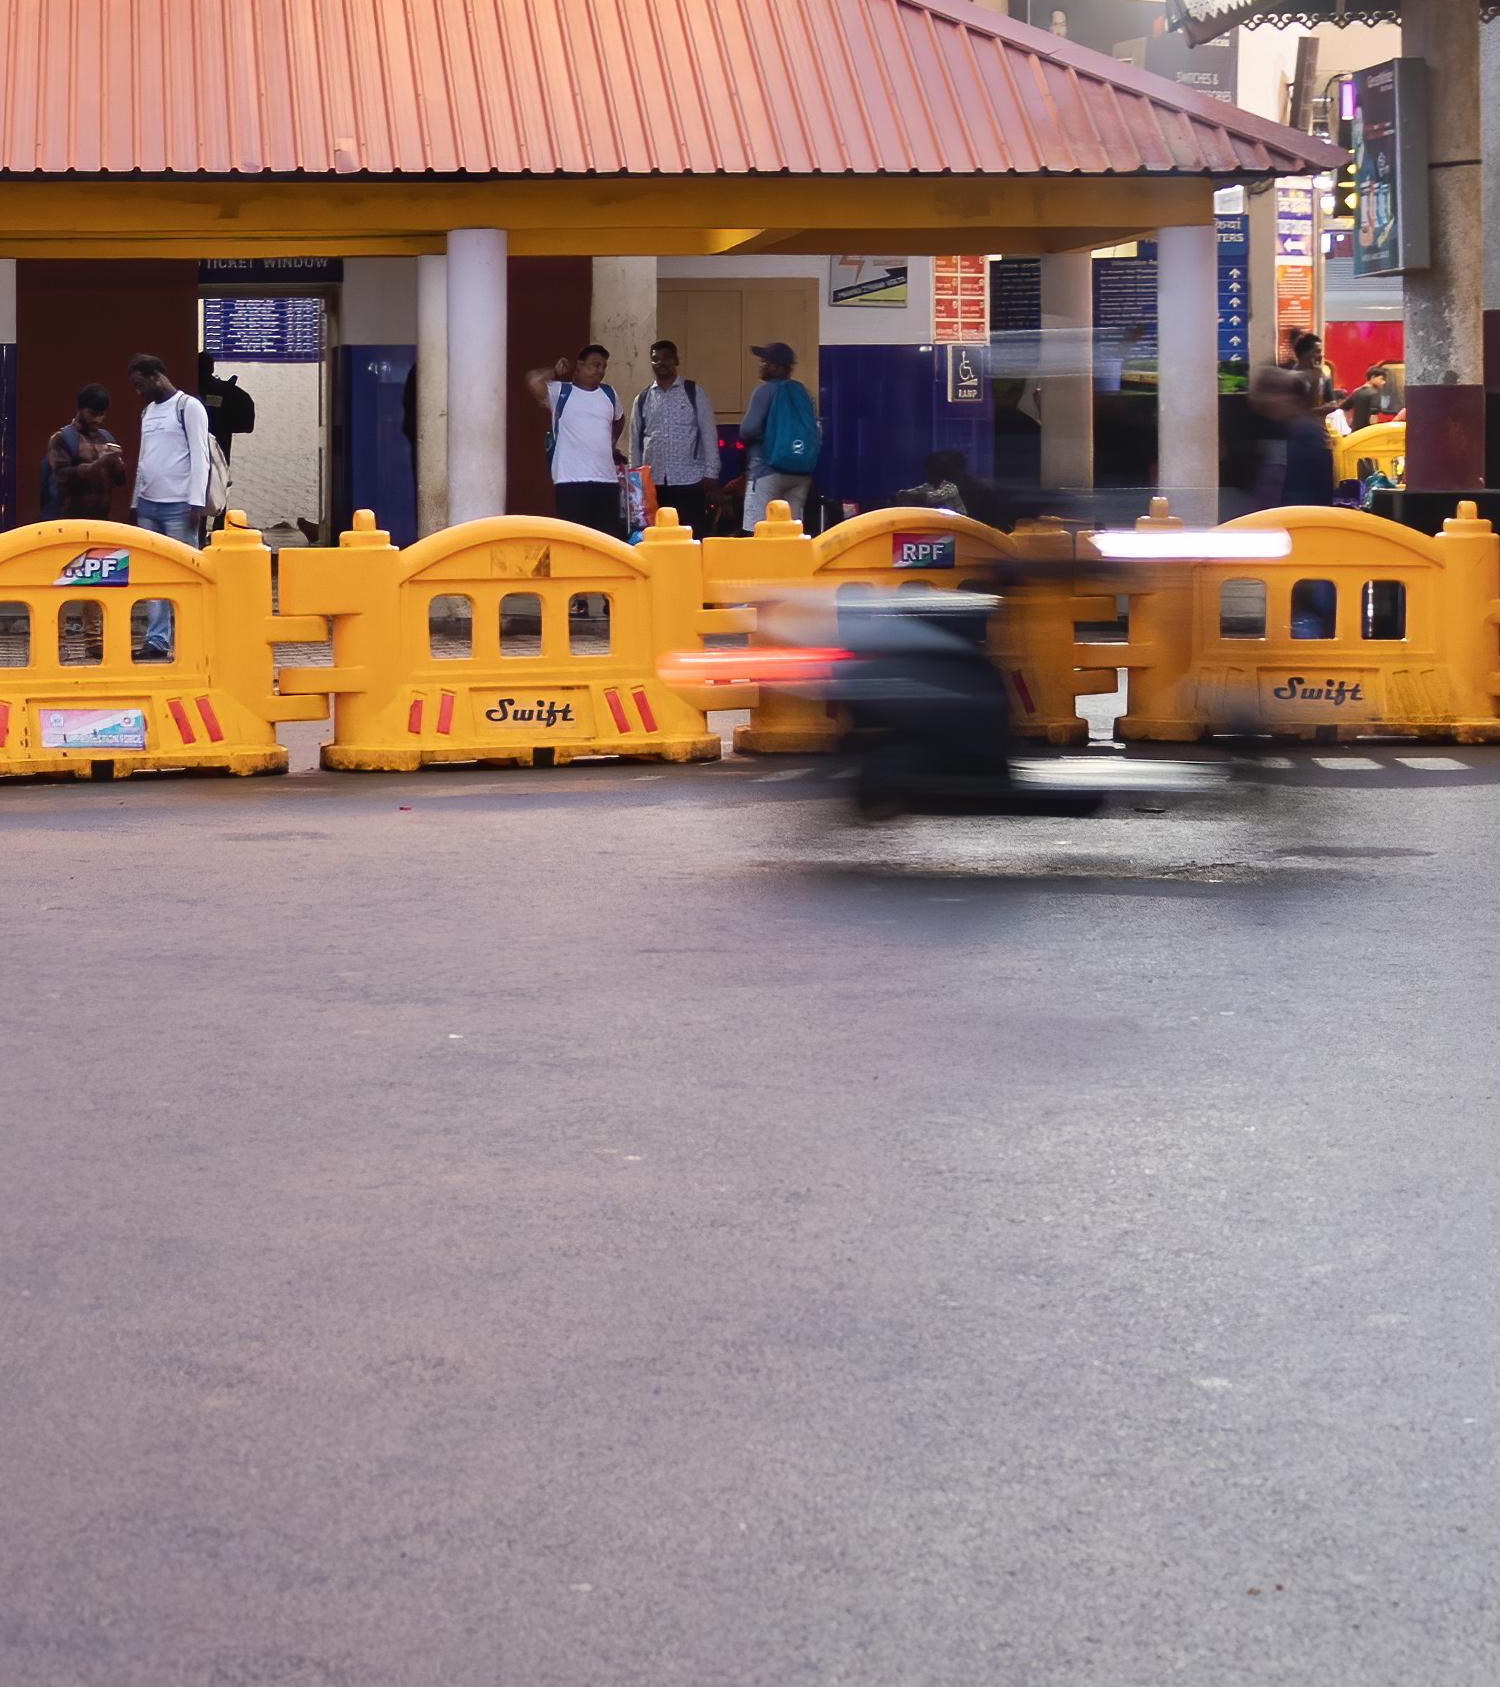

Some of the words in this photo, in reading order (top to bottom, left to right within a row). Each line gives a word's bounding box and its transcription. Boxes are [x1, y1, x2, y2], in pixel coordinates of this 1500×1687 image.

[903, 543, 945, 561] RPF
[1273, 676, 1364, 706] Swift
[485, 698, 575, 728] Swift
